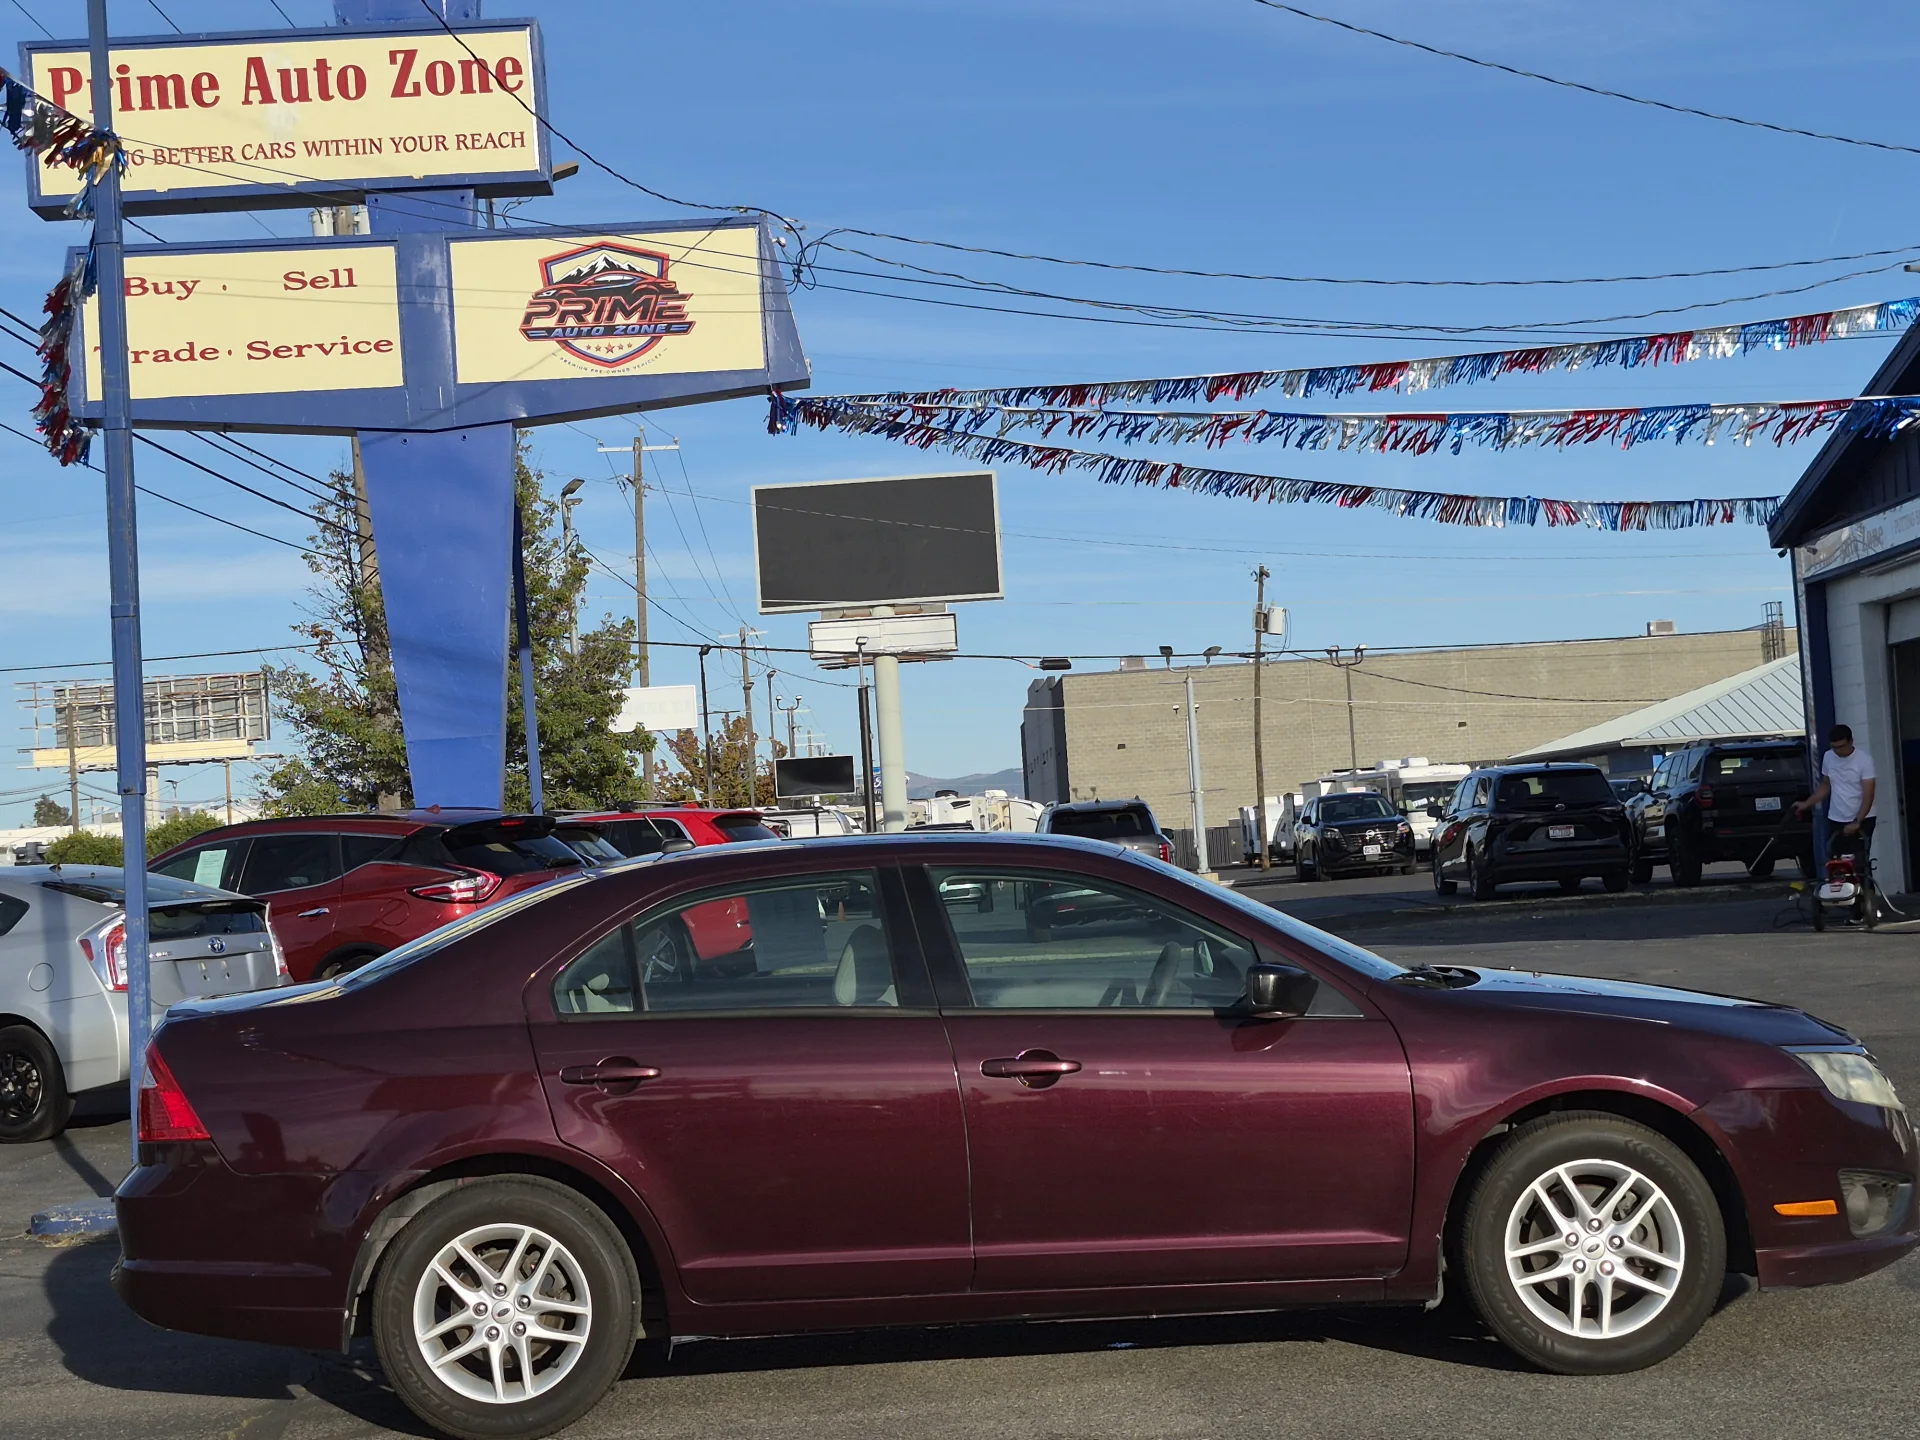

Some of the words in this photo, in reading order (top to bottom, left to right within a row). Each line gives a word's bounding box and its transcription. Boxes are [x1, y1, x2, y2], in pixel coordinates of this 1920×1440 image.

[47, 63, 221, 114] Pime
[241, 56, 367, 106] Auto
[388, 48, 524, 99] Zone
[153, 146, 236, 166] BETTER
[240, 141, 297, 161] CARS
[302, 137, 384, 158] WITHIN
[389, 133, 447, 154] YOUR
[455, 130, 526, 151] REACH
[123, 276, 201, 301] Buy
[282, 267, 358, 292] Sell
[520, 293, 694, 327] PRIME
[550, 326, 605, 338] AUTO
[613, 323, 668, 336] ZONE
[93, 341, 220, 364] rade
[246, 335, 394, 361] Service
